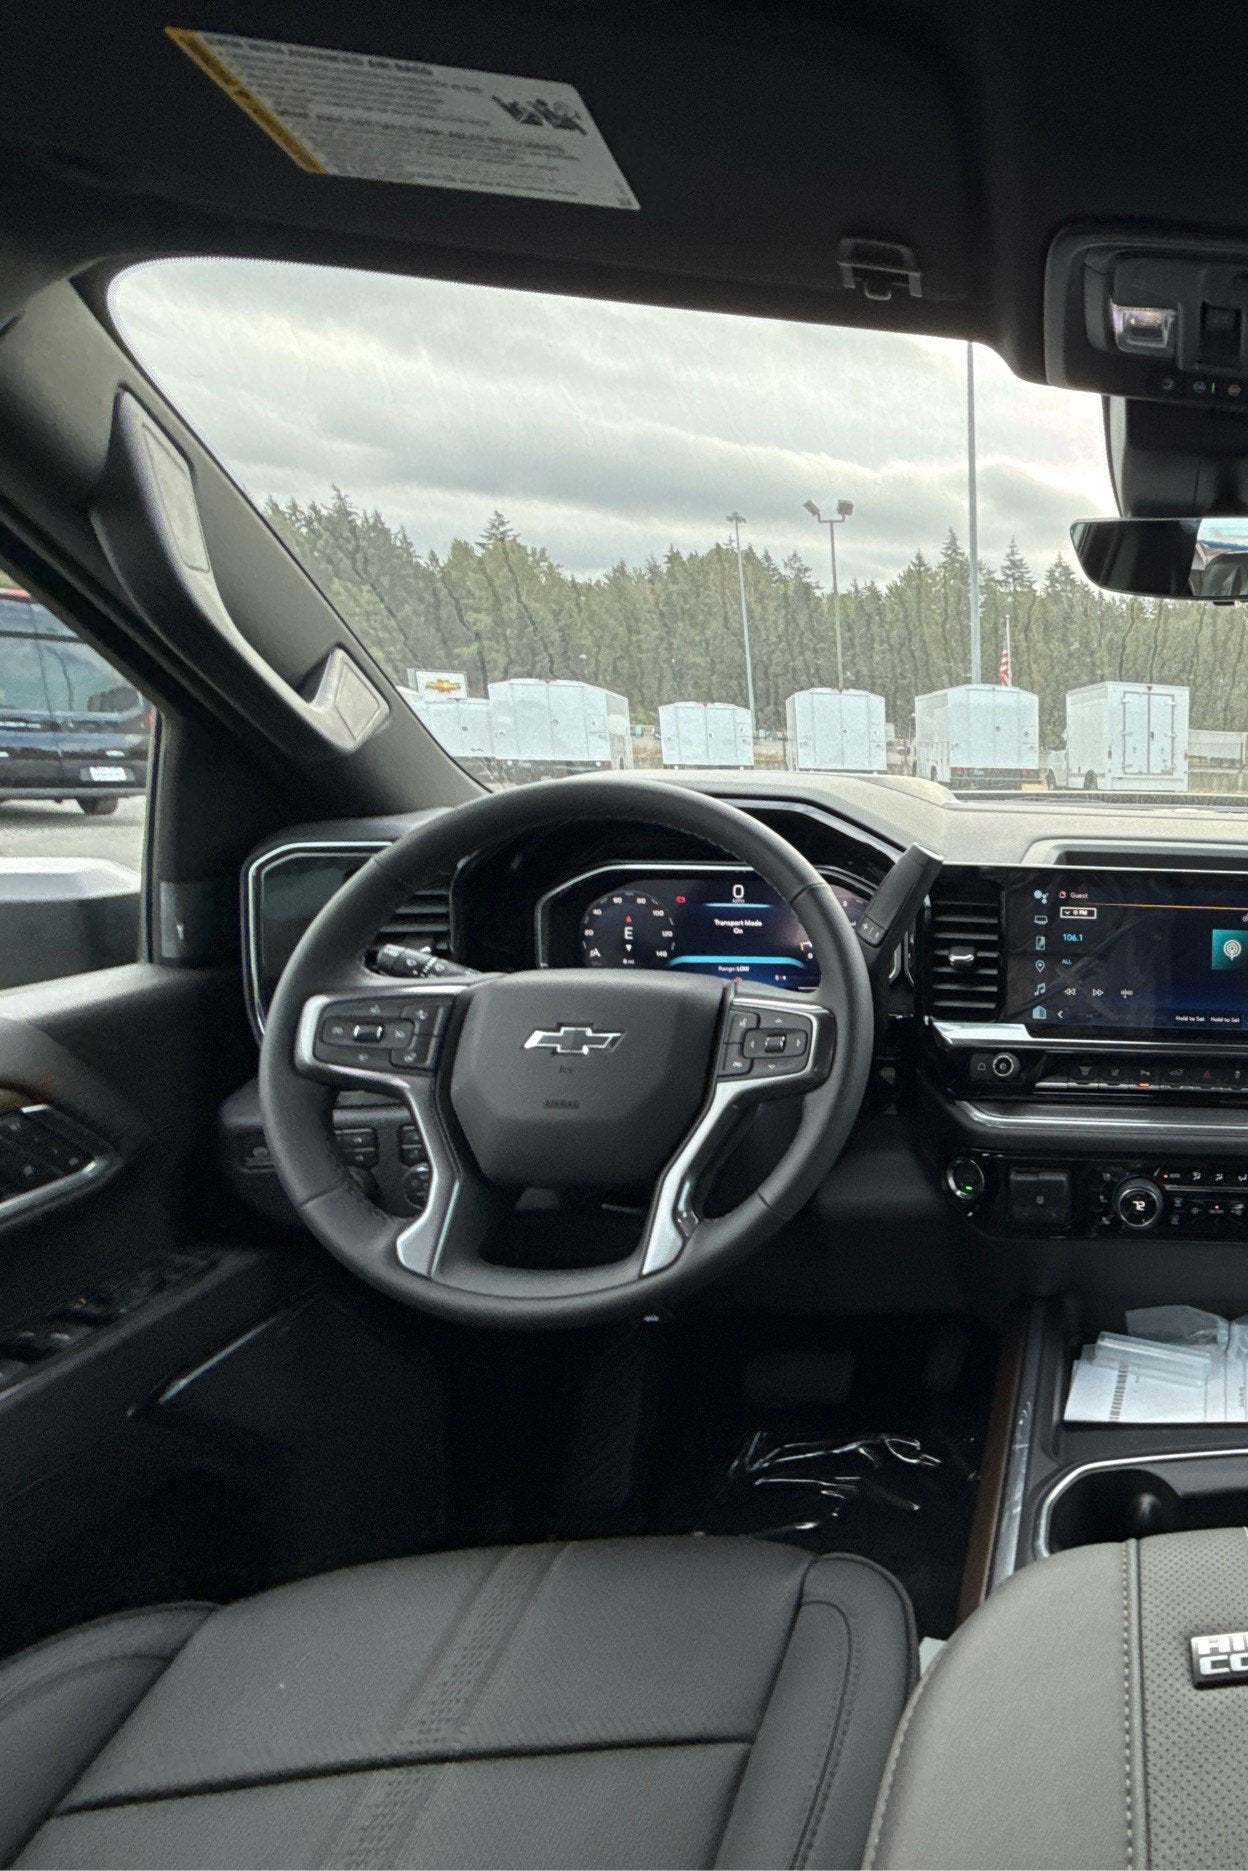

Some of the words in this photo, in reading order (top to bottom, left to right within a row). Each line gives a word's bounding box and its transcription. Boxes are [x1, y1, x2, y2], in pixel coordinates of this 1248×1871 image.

[732, 884, 744, 899] 0
[1070, 891, 1089, 899] Guest
[592, 908, 602, 916] 40
[652, 909, 664, 917] 100
[714, 918, 744, 928] Transport
[744, 919, 762, 927] Mode
[661, 930, 673, 938] 120
[733, 927, 743, 935] On
[1063, 933, 1083, 942] 106.1
[656, 950, 668, 958] 140
[736, 965, 750, 973] LOW
